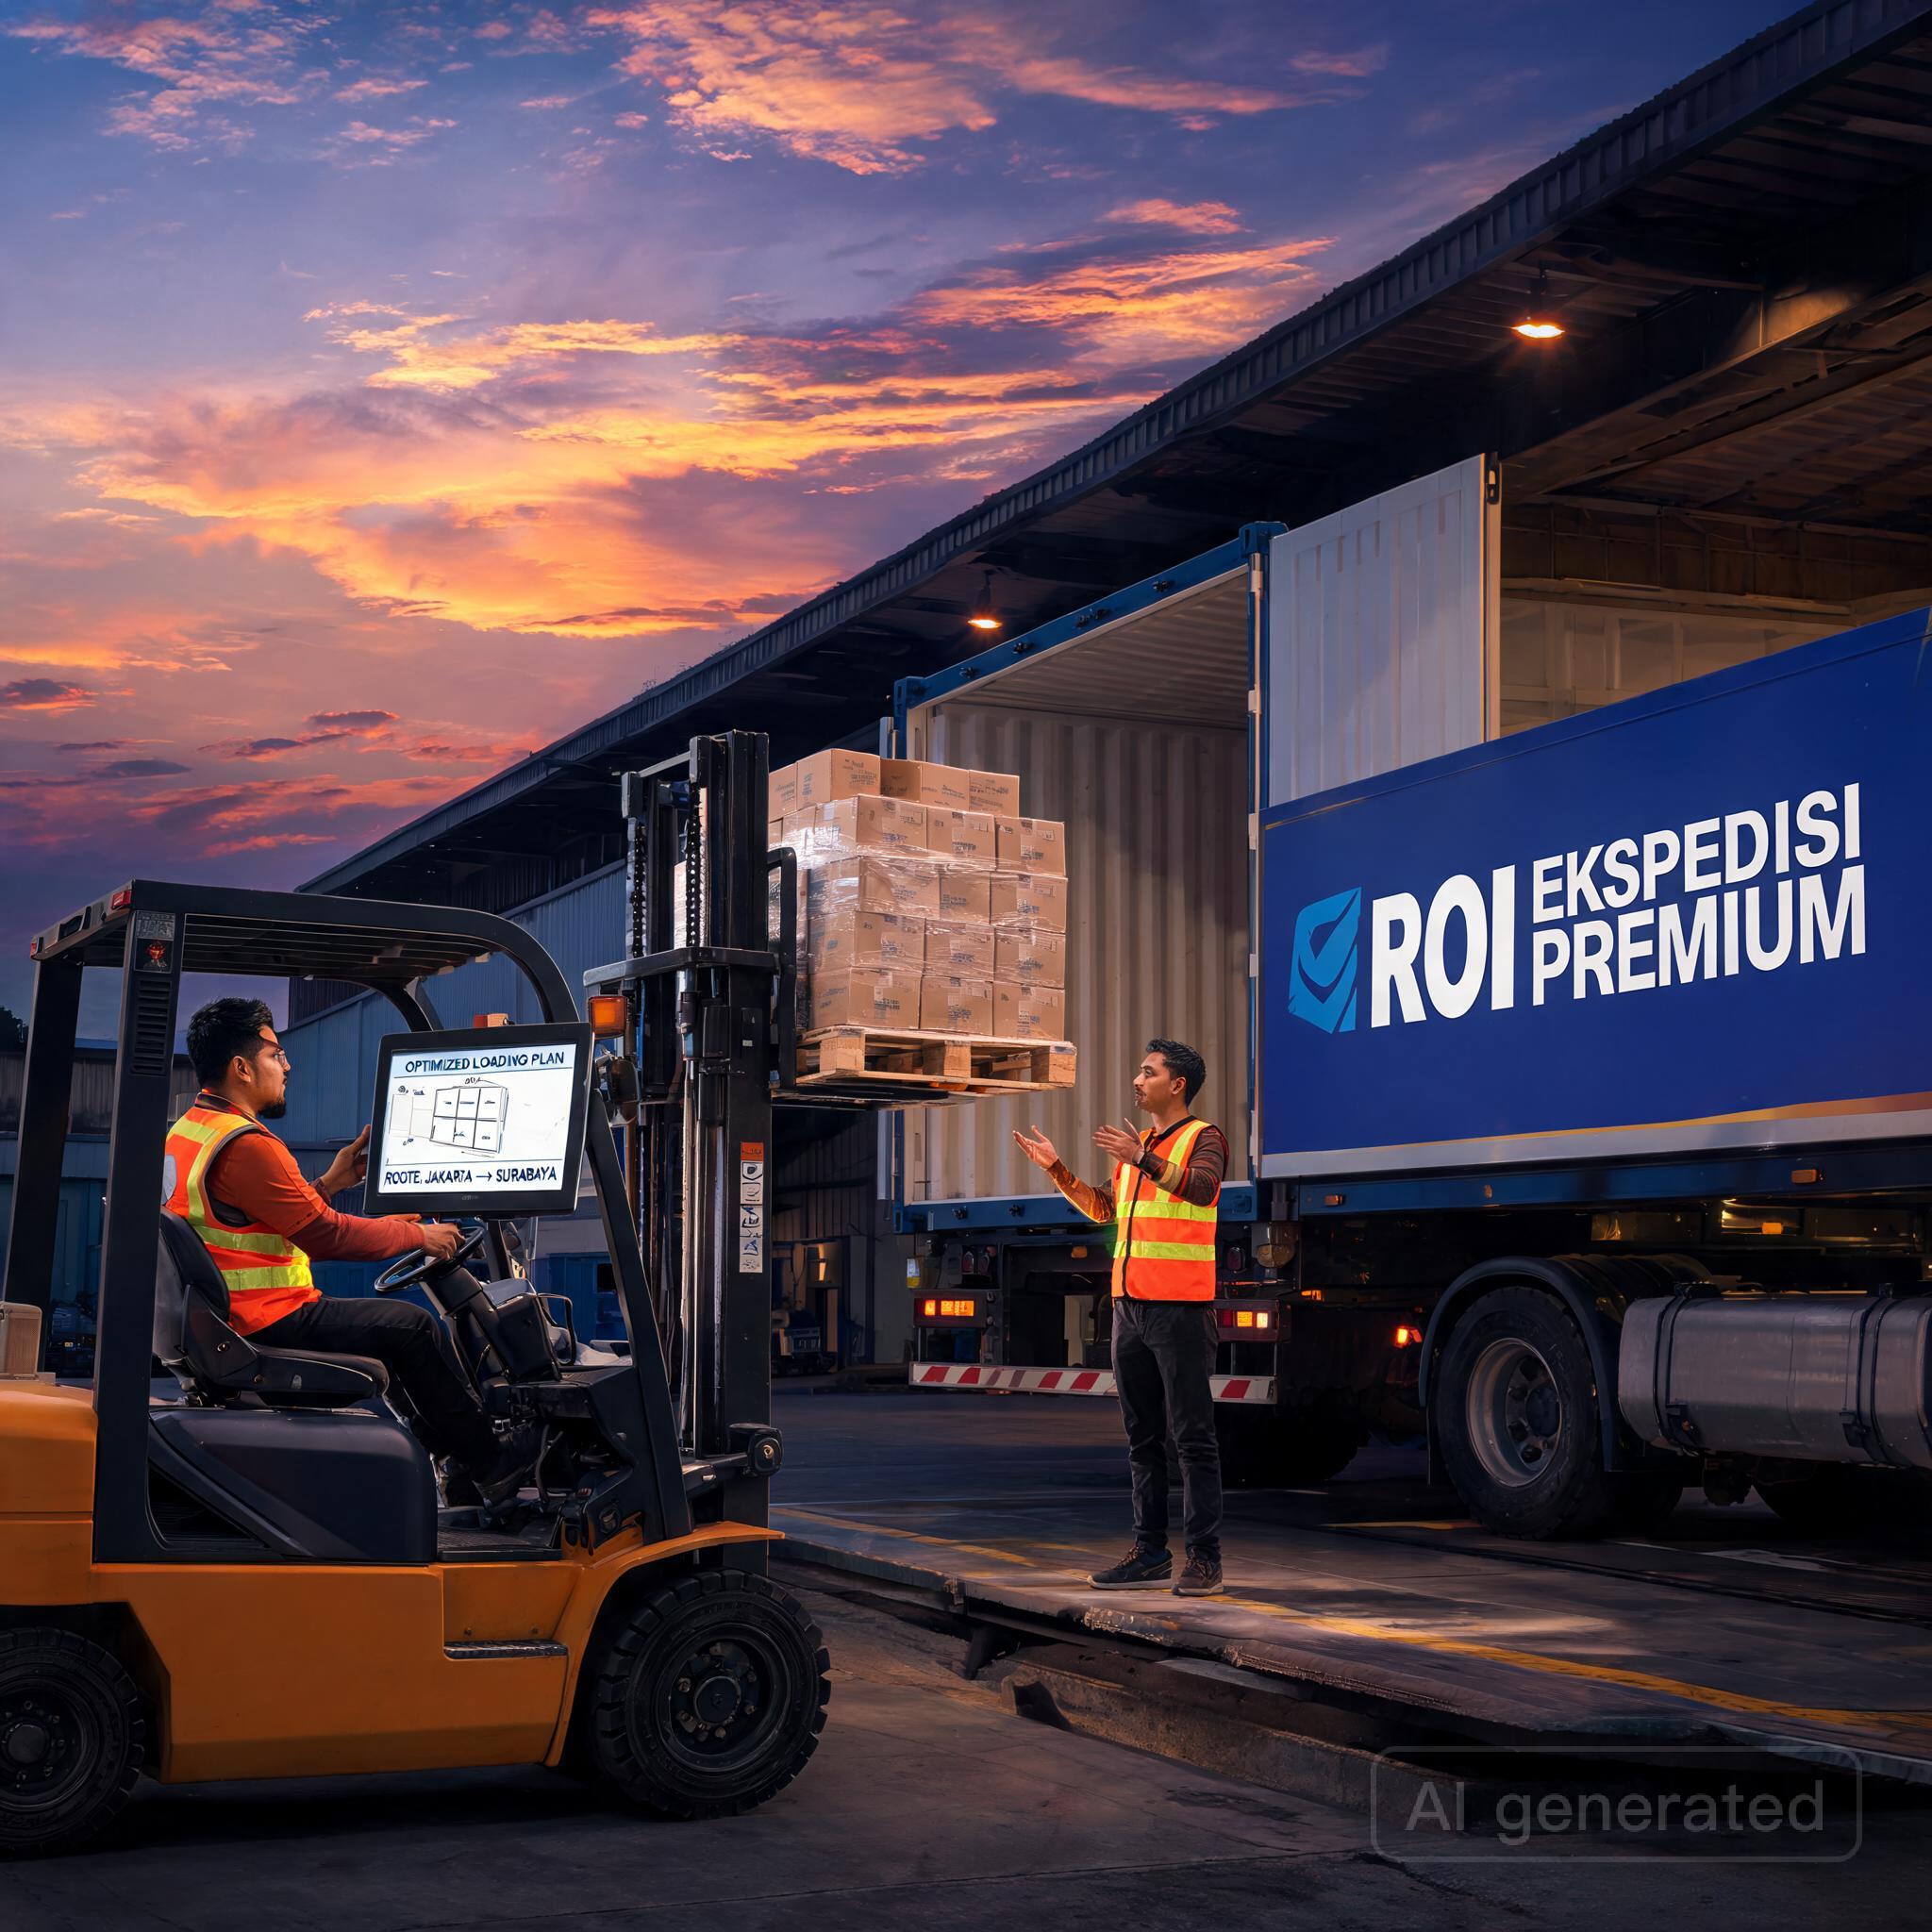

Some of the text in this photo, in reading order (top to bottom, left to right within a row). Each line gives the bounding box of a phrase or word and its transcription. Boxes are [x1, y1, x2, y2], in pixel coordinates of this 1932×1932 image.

[1533, 782, 1860, 924] EKSPEDISI
[1371, 864, 1516, 1028] ROI
[1532, 864, 1867, 1007] PREMIUM
[405, 1051, 565, 1074] OPTIMIZED LOADING PLAN
[495, 1166, 558, 1183] SURABAYA
